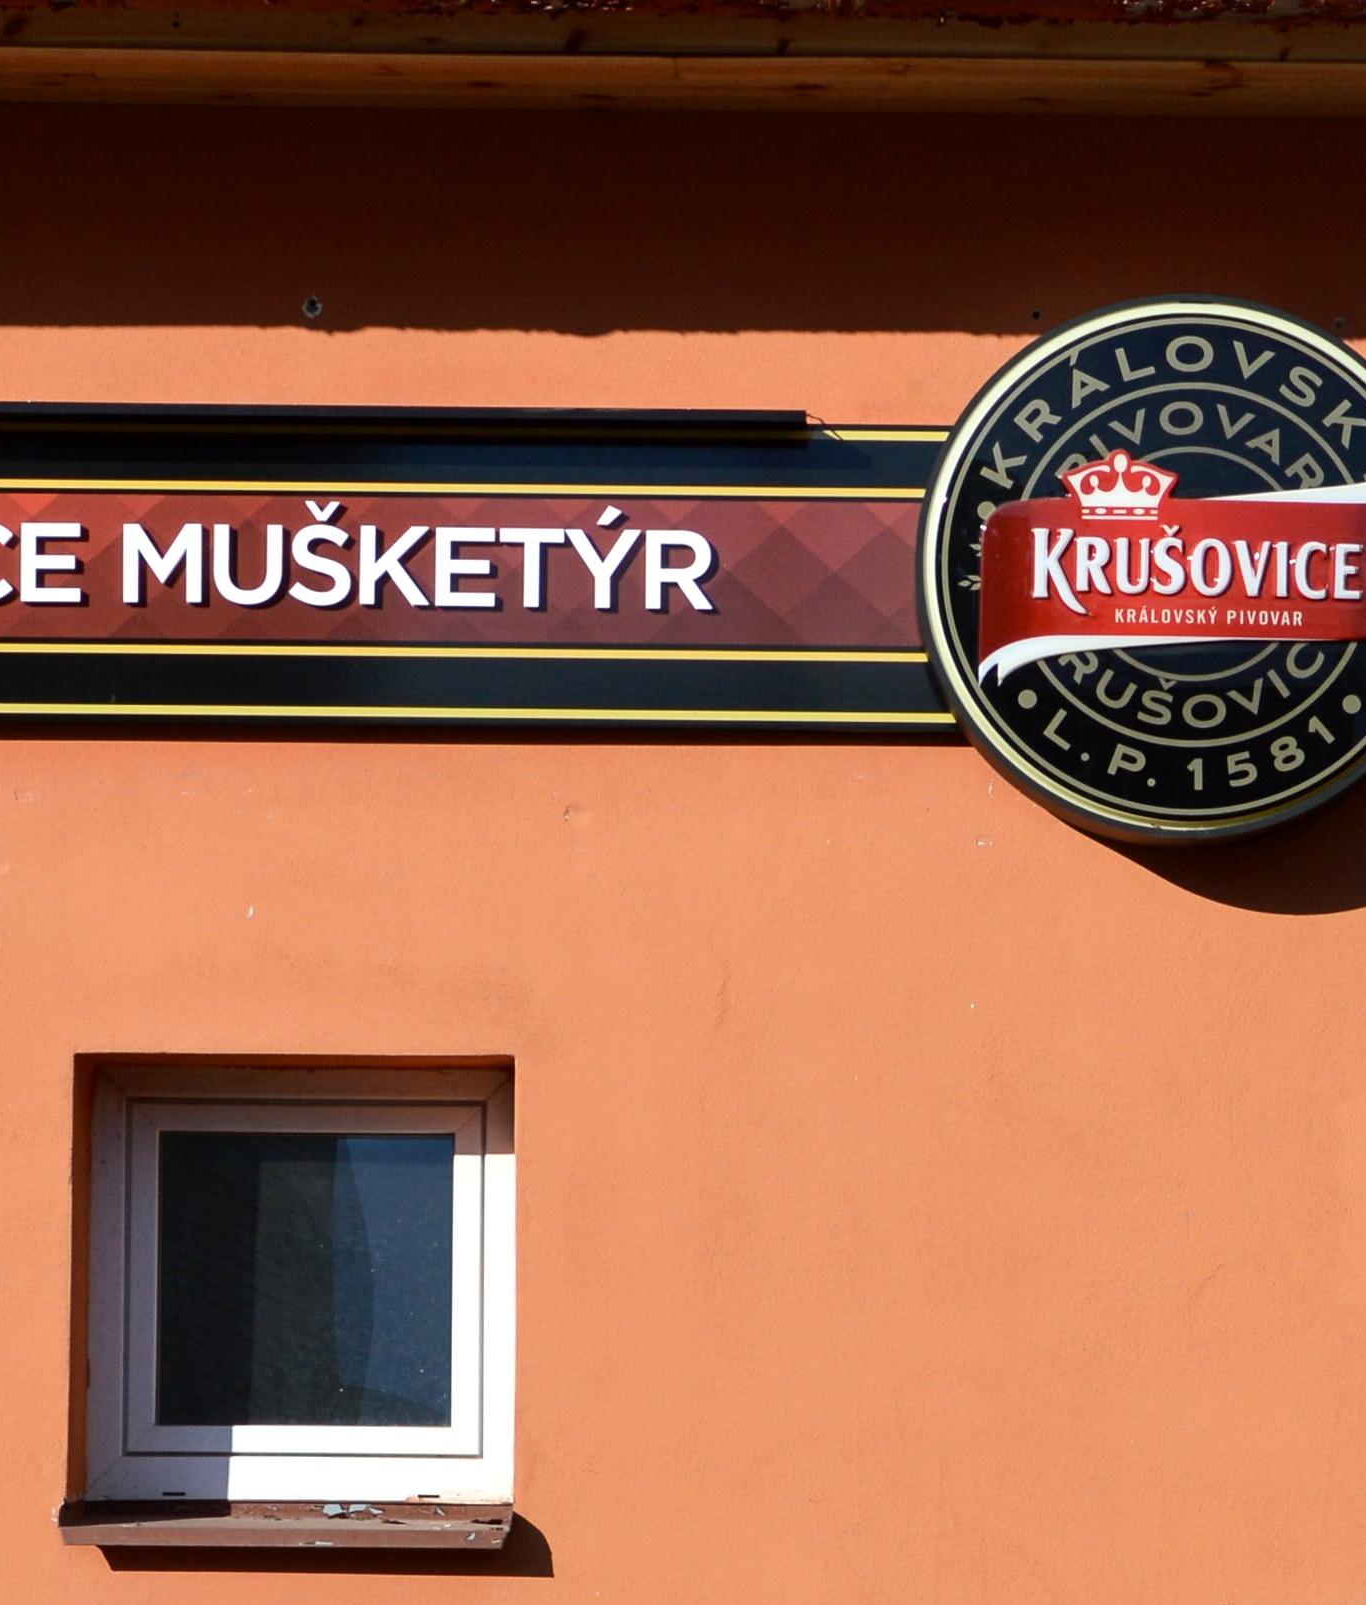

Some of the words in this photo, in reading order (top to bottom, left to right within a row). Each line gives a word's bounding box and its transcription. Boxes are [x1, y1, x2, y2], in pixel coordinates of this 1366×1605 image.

[122, 500, 714, 611] MUŠKETÝR
[1031, 525, 1364, 617] KRUŠOVICE
[1114, 605, 1218, 625] KRÁLOVSKÝ
[1227, 608, 1303, 627] PIVOVAR
[1057, 642, 1325, 729] RUŠOVIC
[1187, 716, 1336, 791] 1581
